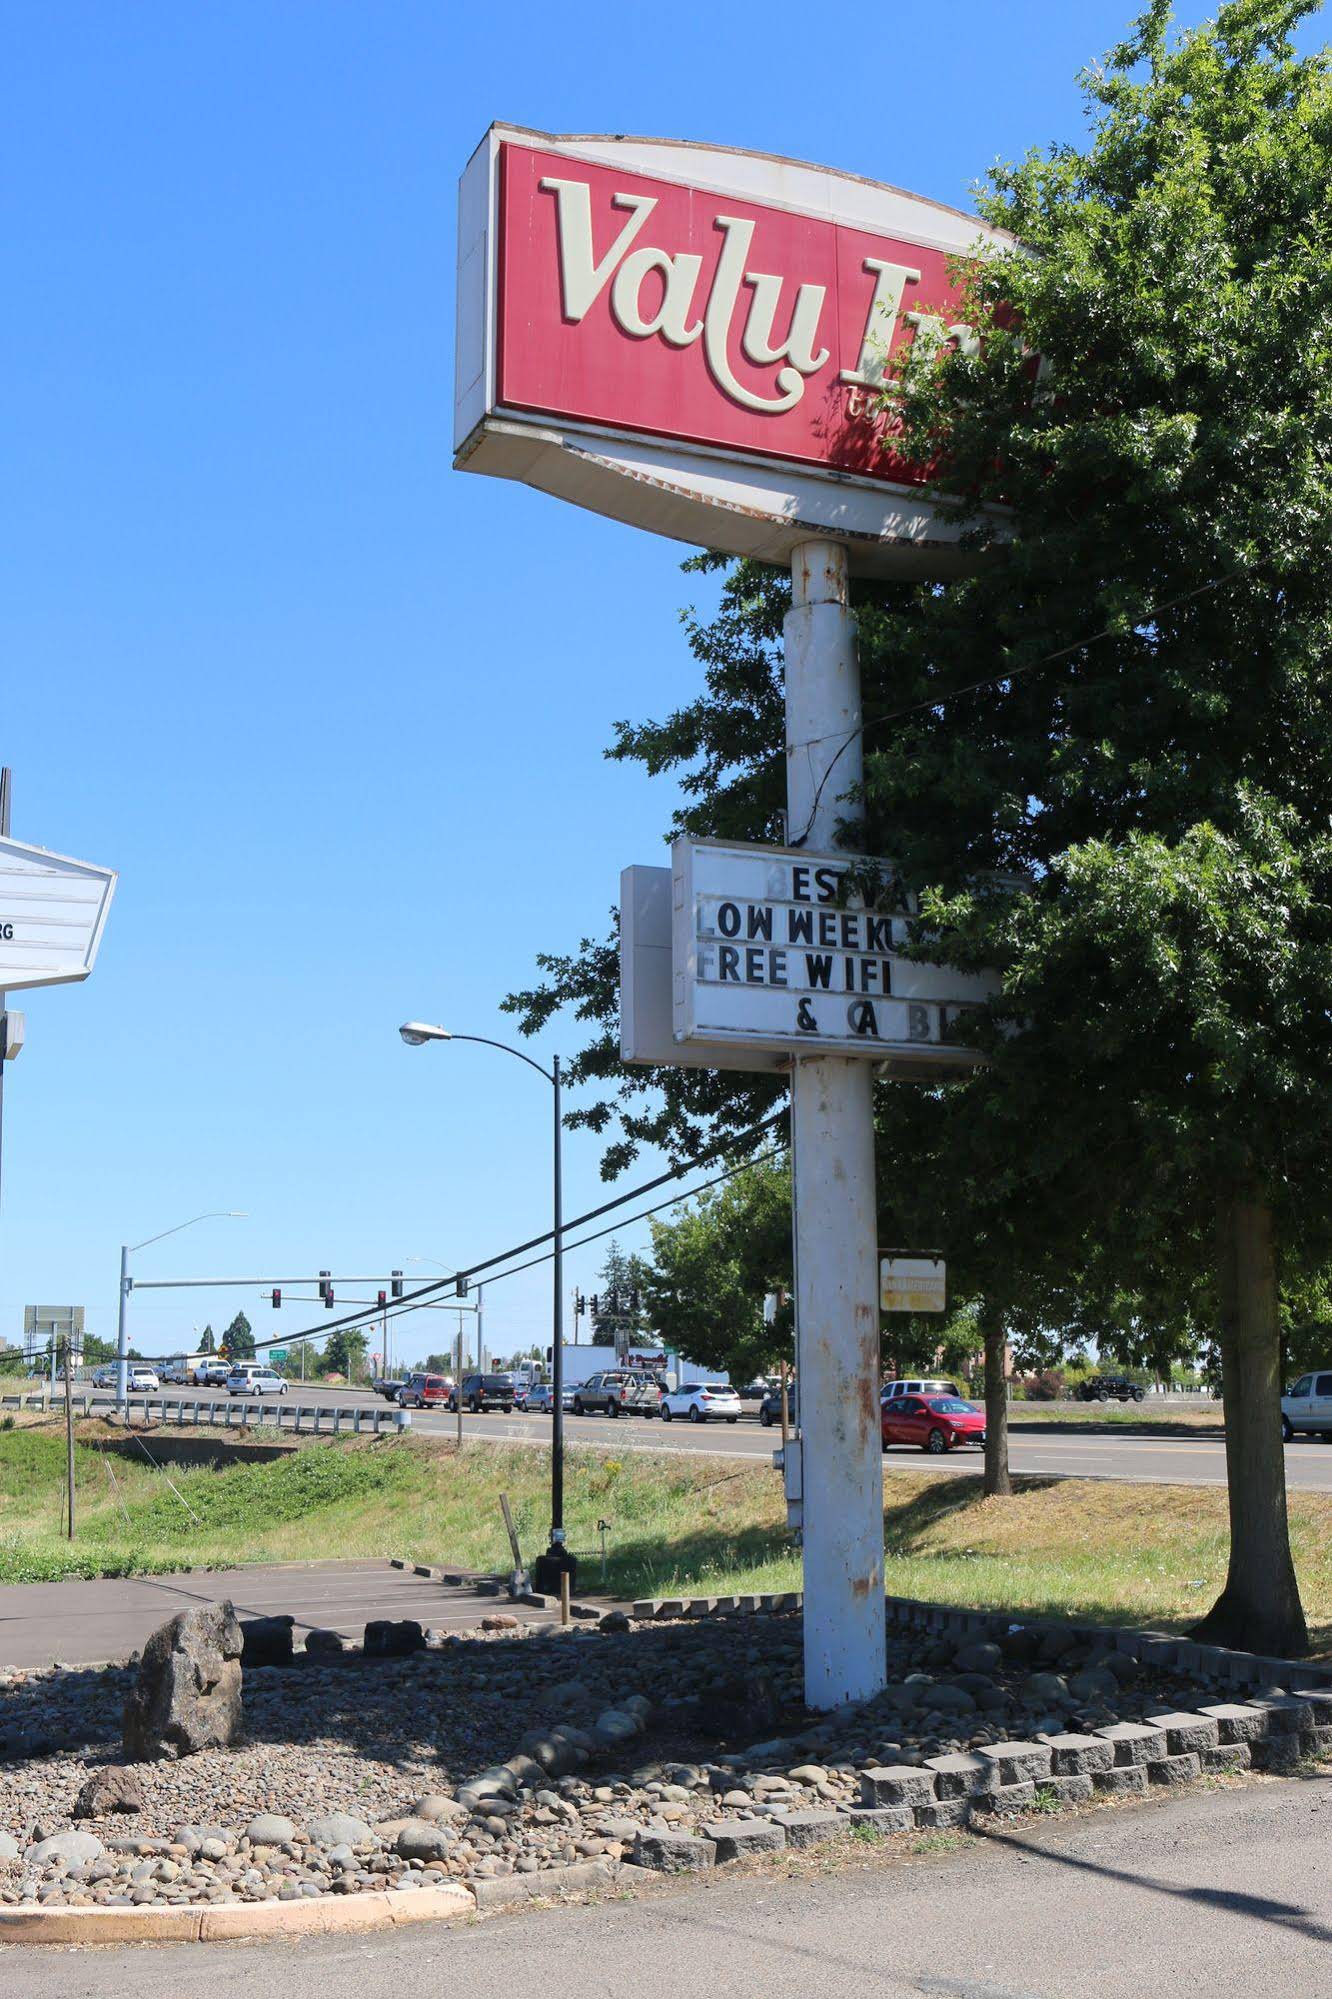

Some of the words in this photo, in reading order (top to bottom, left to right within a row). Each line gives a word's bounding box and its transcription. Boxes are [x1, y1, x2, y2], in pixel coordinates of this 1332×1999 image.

[540, 177, 830, 413] Valu
[697, 945, 787, 986] FREE
[805, 953, 891, 994] WIFI
[797, 997, 818, 1031] &
